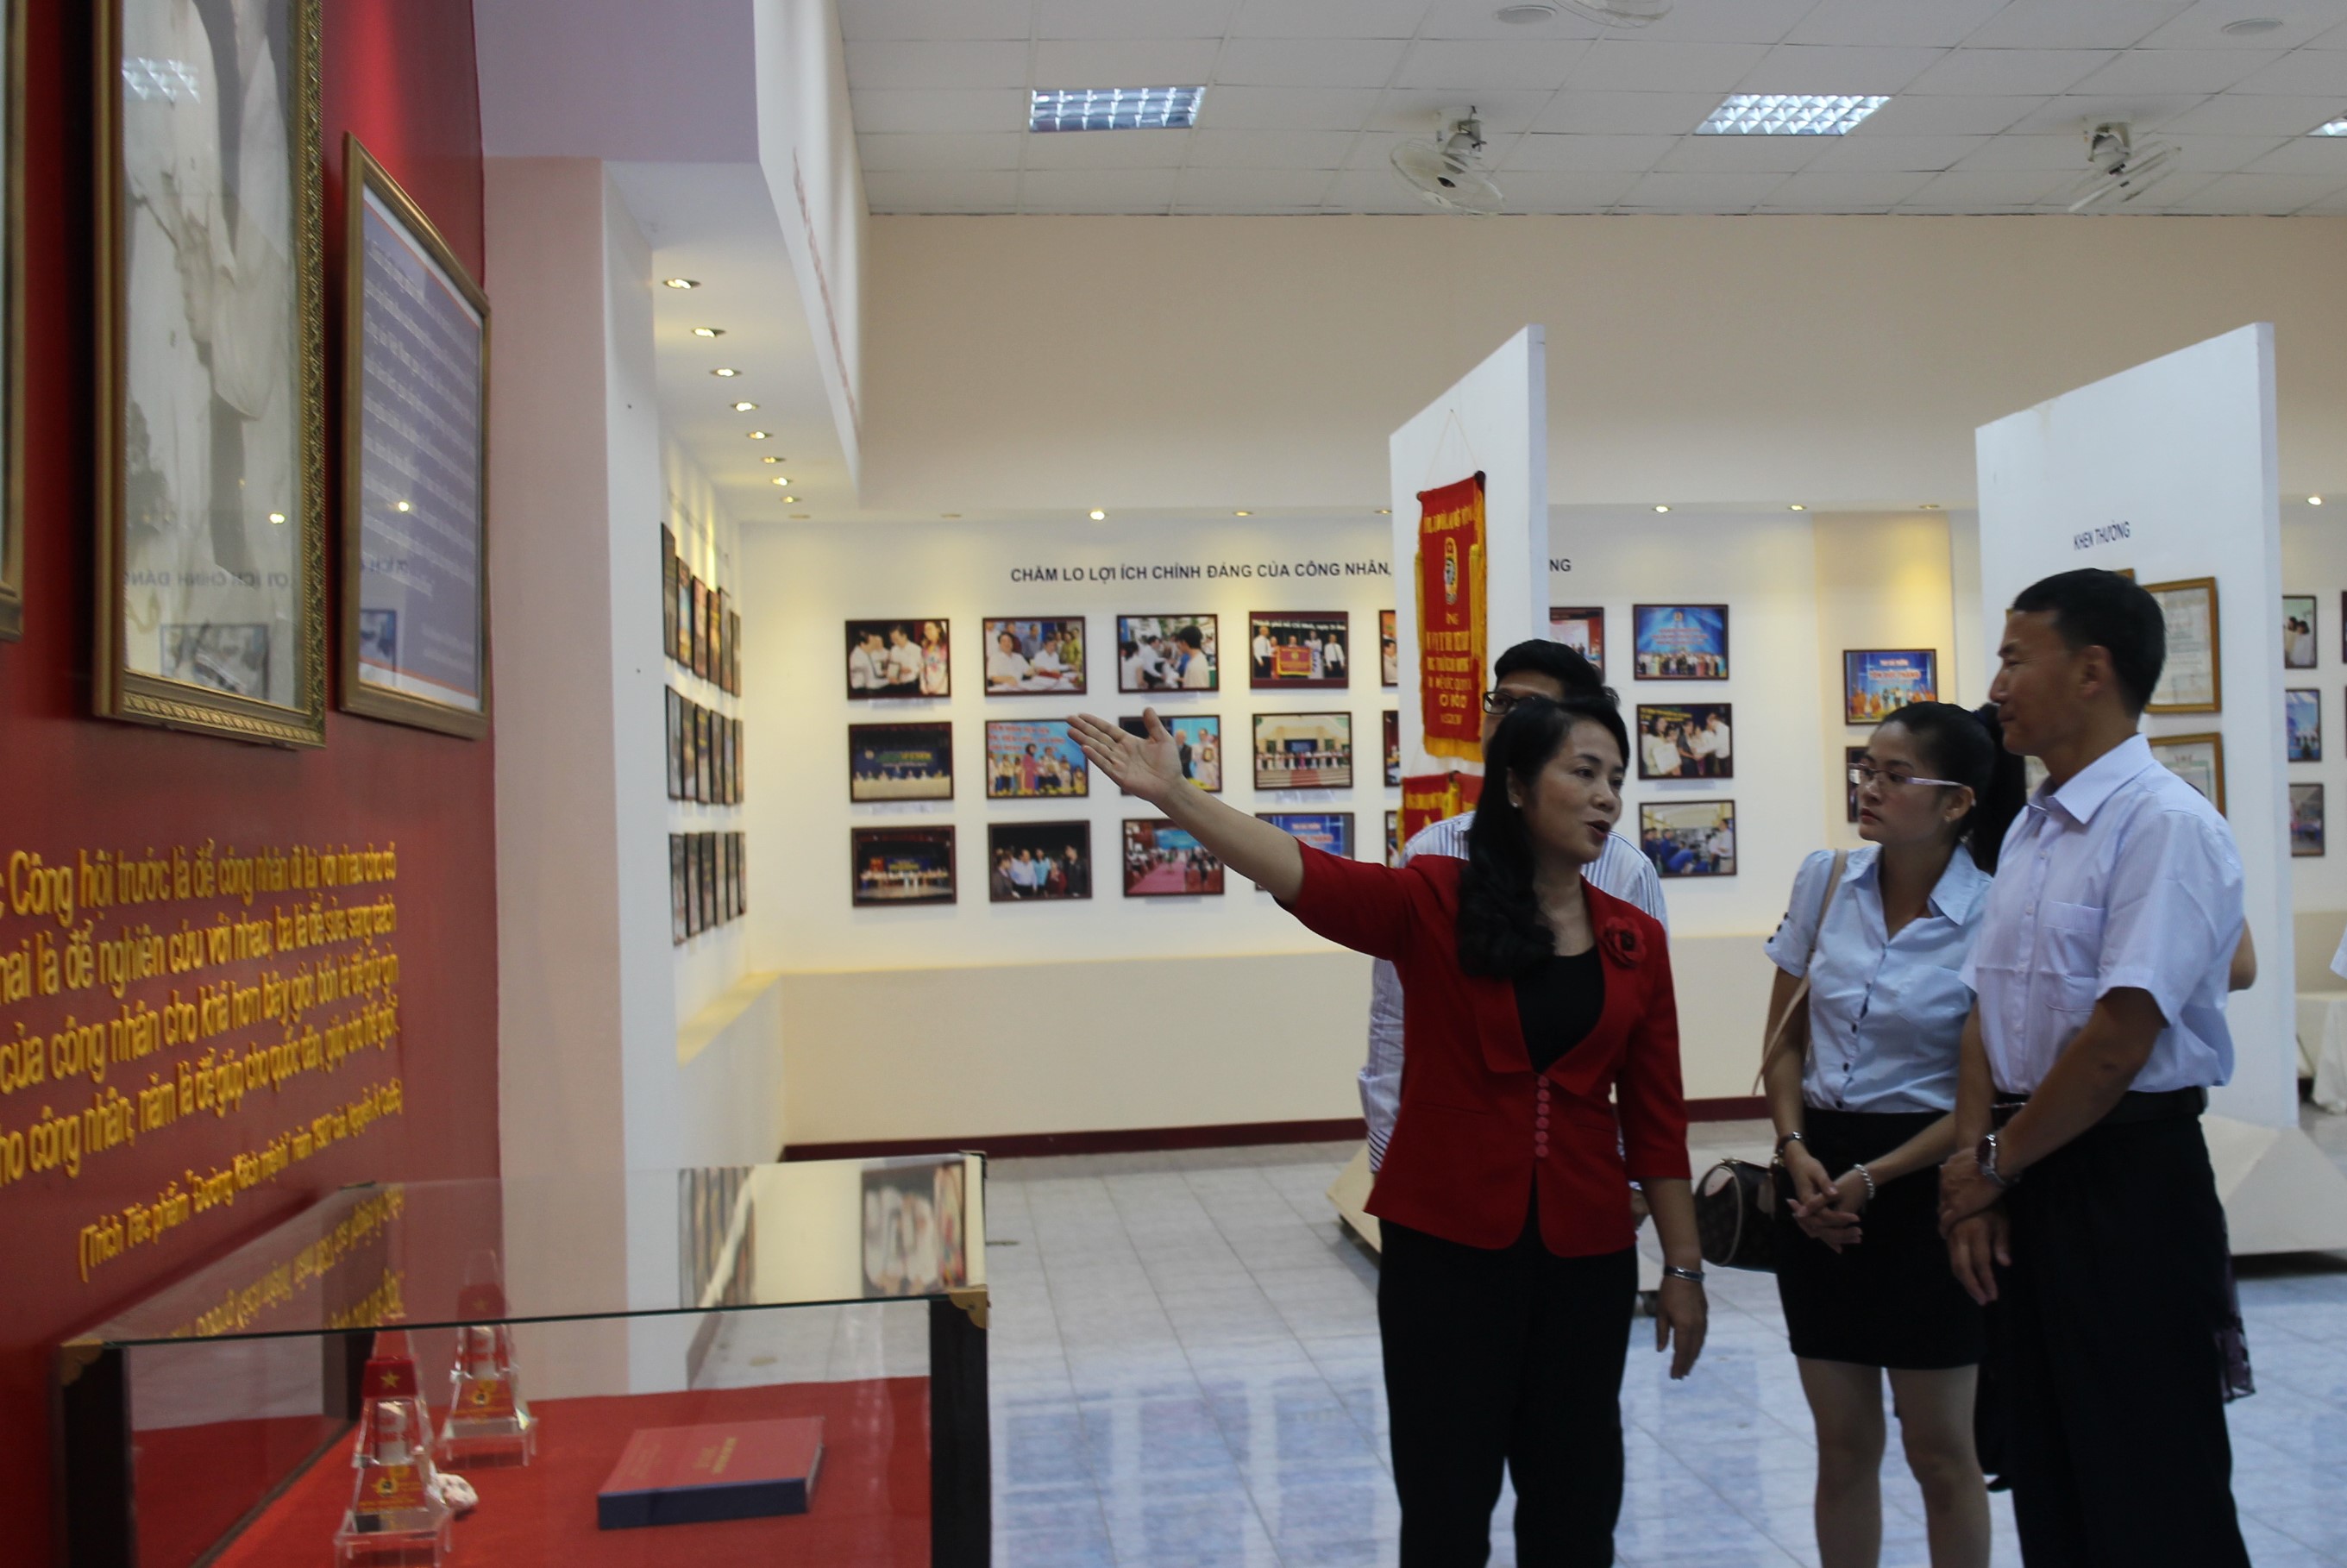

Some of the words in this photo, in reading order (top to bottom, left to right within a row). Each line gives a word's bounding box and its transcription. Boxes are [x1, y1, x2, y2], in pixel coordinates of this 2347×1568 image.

[1010, 565, 1058, 582] CHĂM
[1063, 568, 1084, 581] LO
[1089, 567, 1116, 584] LỢI
[1120, 565, 1148, 580] ÍCH
[1152, 562, 1202, 580] CHÍNH
[1207, 561, 1252, 579] ĐÁNG
[1257, 561, 1291, 578] CỦA
[1294, 560, 1340, 577] CÔNG
[1549, 558, 1572, 572] NG
[9, 850, 74, 928] Công
[78, 848, 113, 920] hội
[117, 846, 171, 904] trước
[172, 844, 191, 900] là
[193, 837, 216, 899] để
[218, 844, 254, 906] công
[35, 930, 60, 996] là
[65, 919, 94, 990] để
[97, 924, 166, 1000] nghiên
[168, 918, 204, 974] cứu
[204, 911, 232, 965] với
[0, 1020, 45, 1095] của
[51, 1014, 106, 1084] công
[109, 999, 160, 1063] nhân
[163, 988, 198, 1046] cho
[198, 979, 229, 1038] khá
[260, 969, 290, 1026] bây
[0, 1121, 25, 1186] ho
[29, 1105, 81, 1178] công
[138, 1071, 176, 1133] năm
[176, 1060, 194, 1117] là
[194, 1047, 216, 1111] để
[215, 1048, 245, 1119] giúp
[244, 1040, 269, 1090] cho
